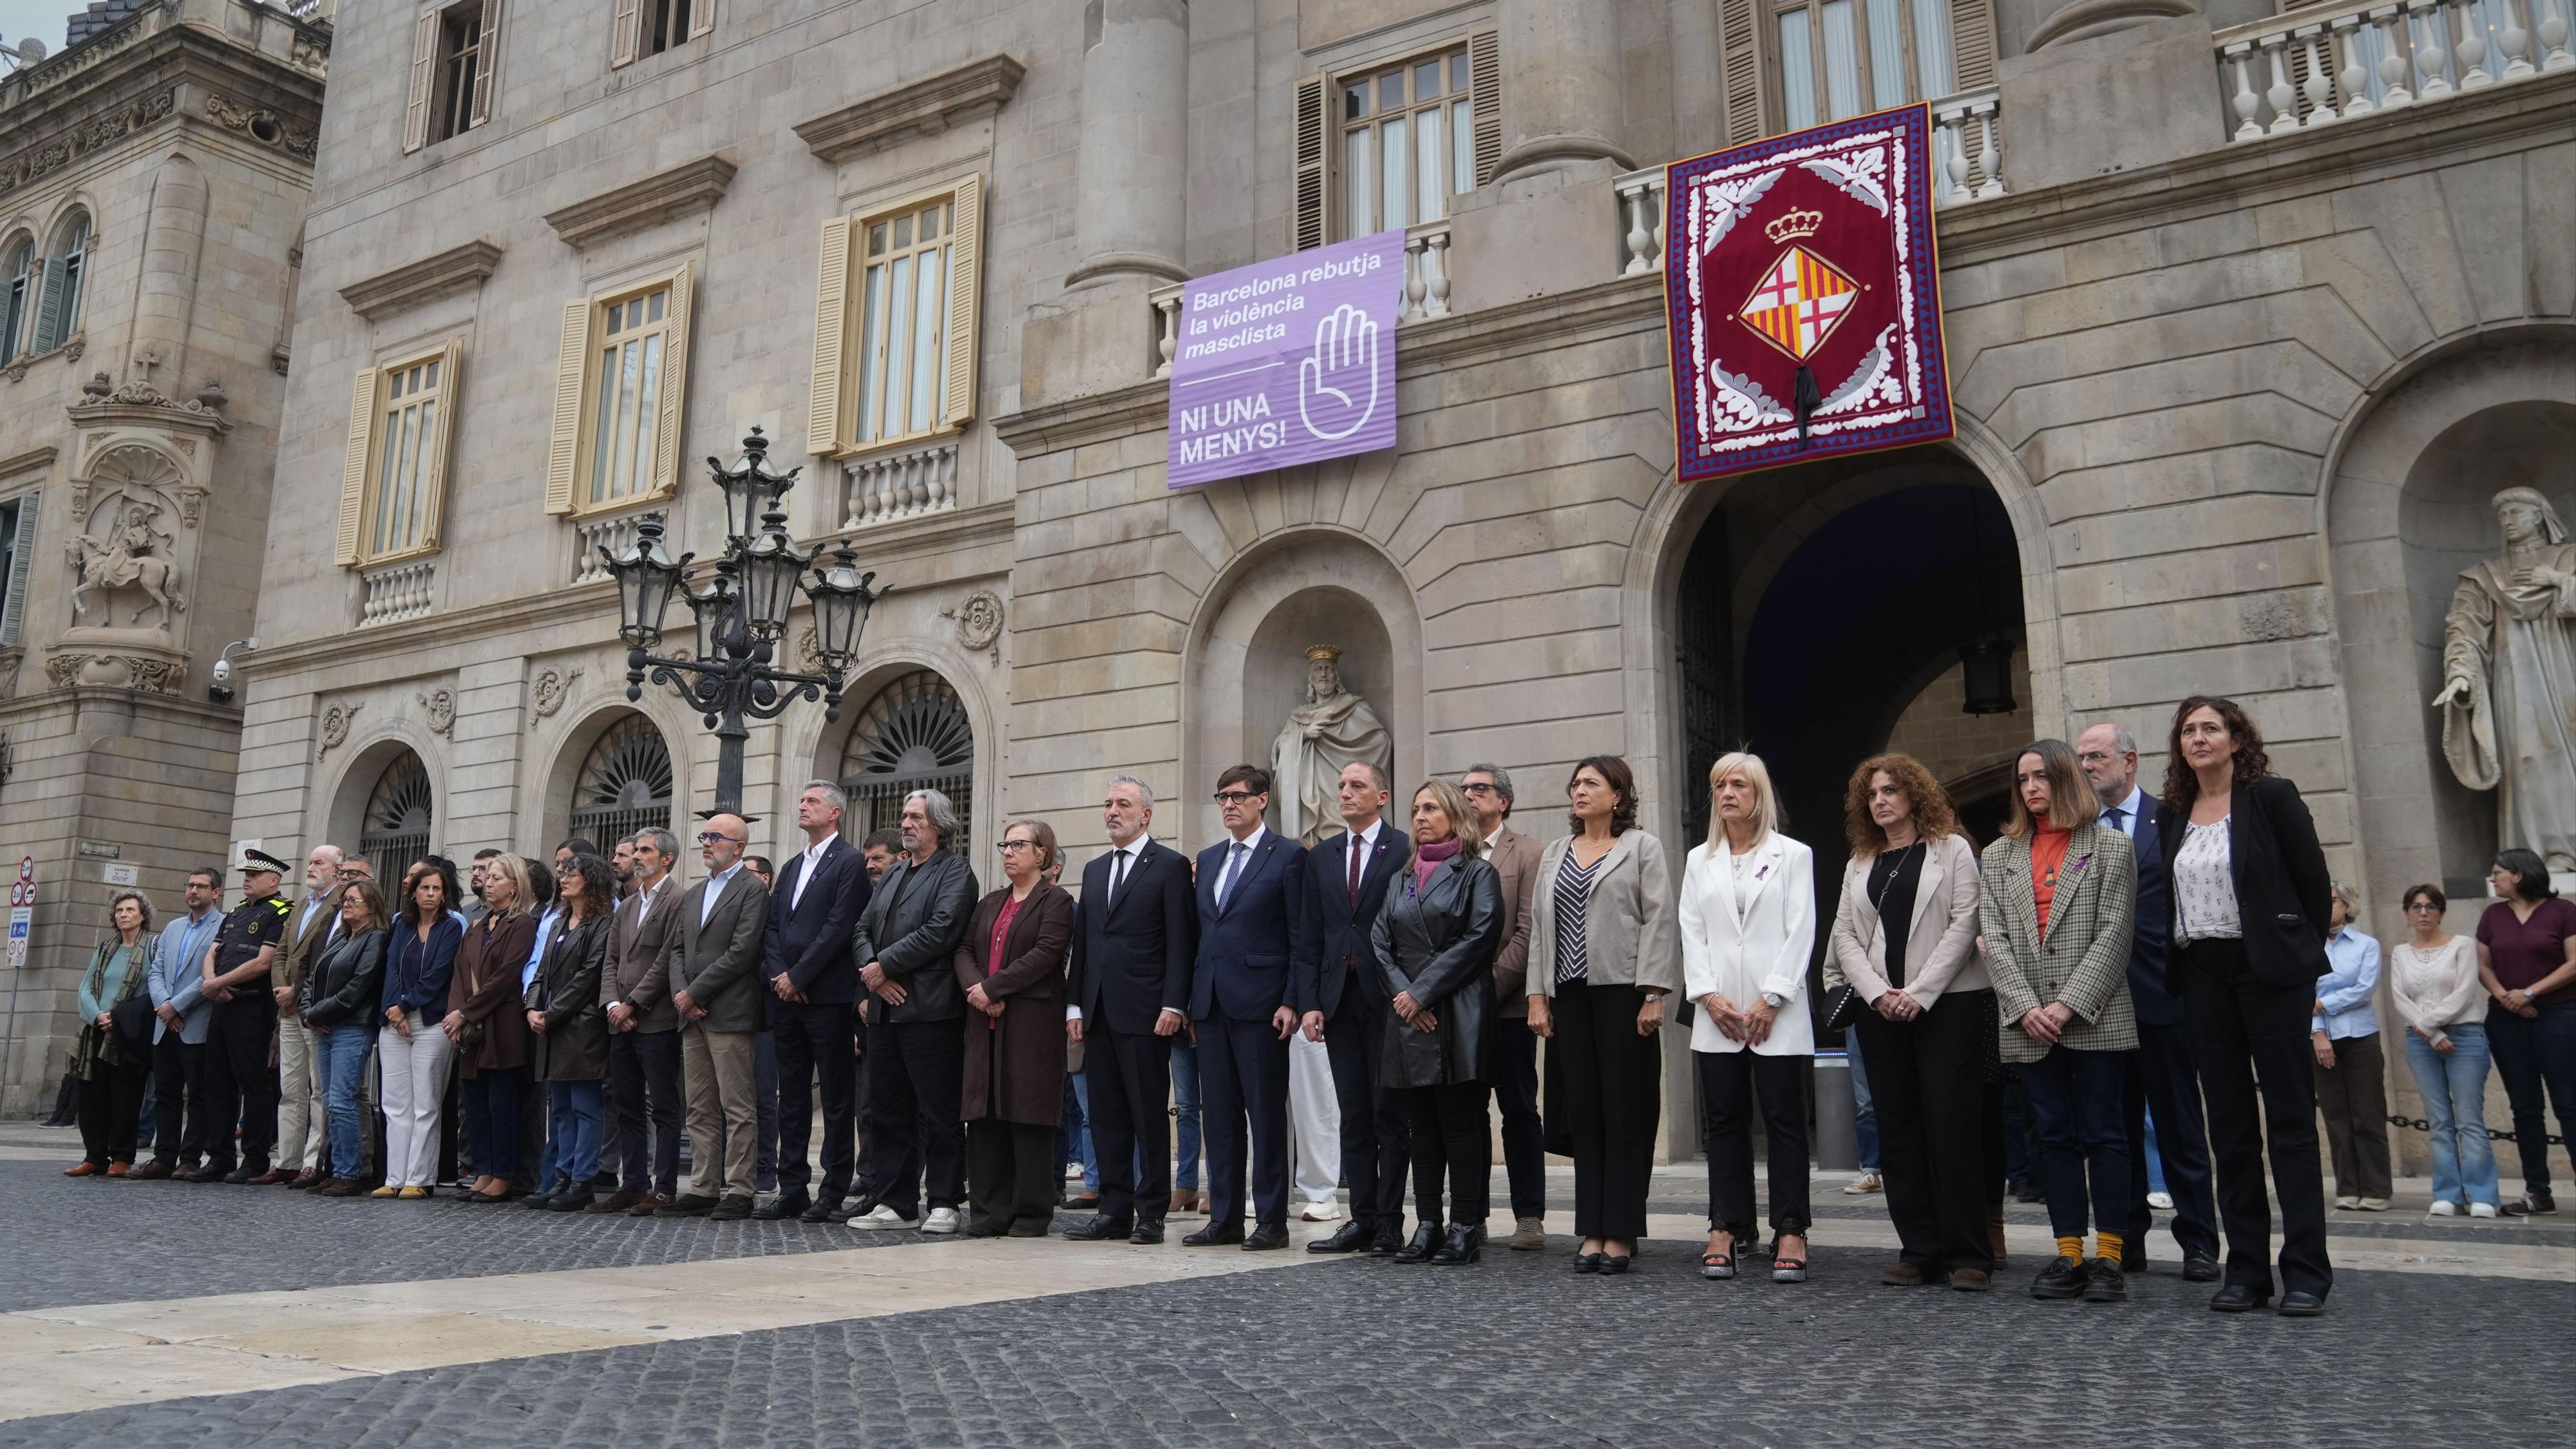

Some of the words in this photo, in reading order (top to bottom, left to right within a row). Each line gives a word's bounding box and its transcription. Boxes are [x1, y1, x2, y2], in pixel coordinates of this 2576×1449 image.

[1193, 273, 1296, 312] Barcelona
[1301, 252, 1381, 285] rebutja
[1189, 317, 1208, 336] la
[1212, 293, 1305, 332] violència
[1185, 323, 1286, 360] masclista
[1180, 406, 1207, 434] NI
[1214, 393, 1271, 427] UNA
[1180, 420, 1286, 465] MENYS!
